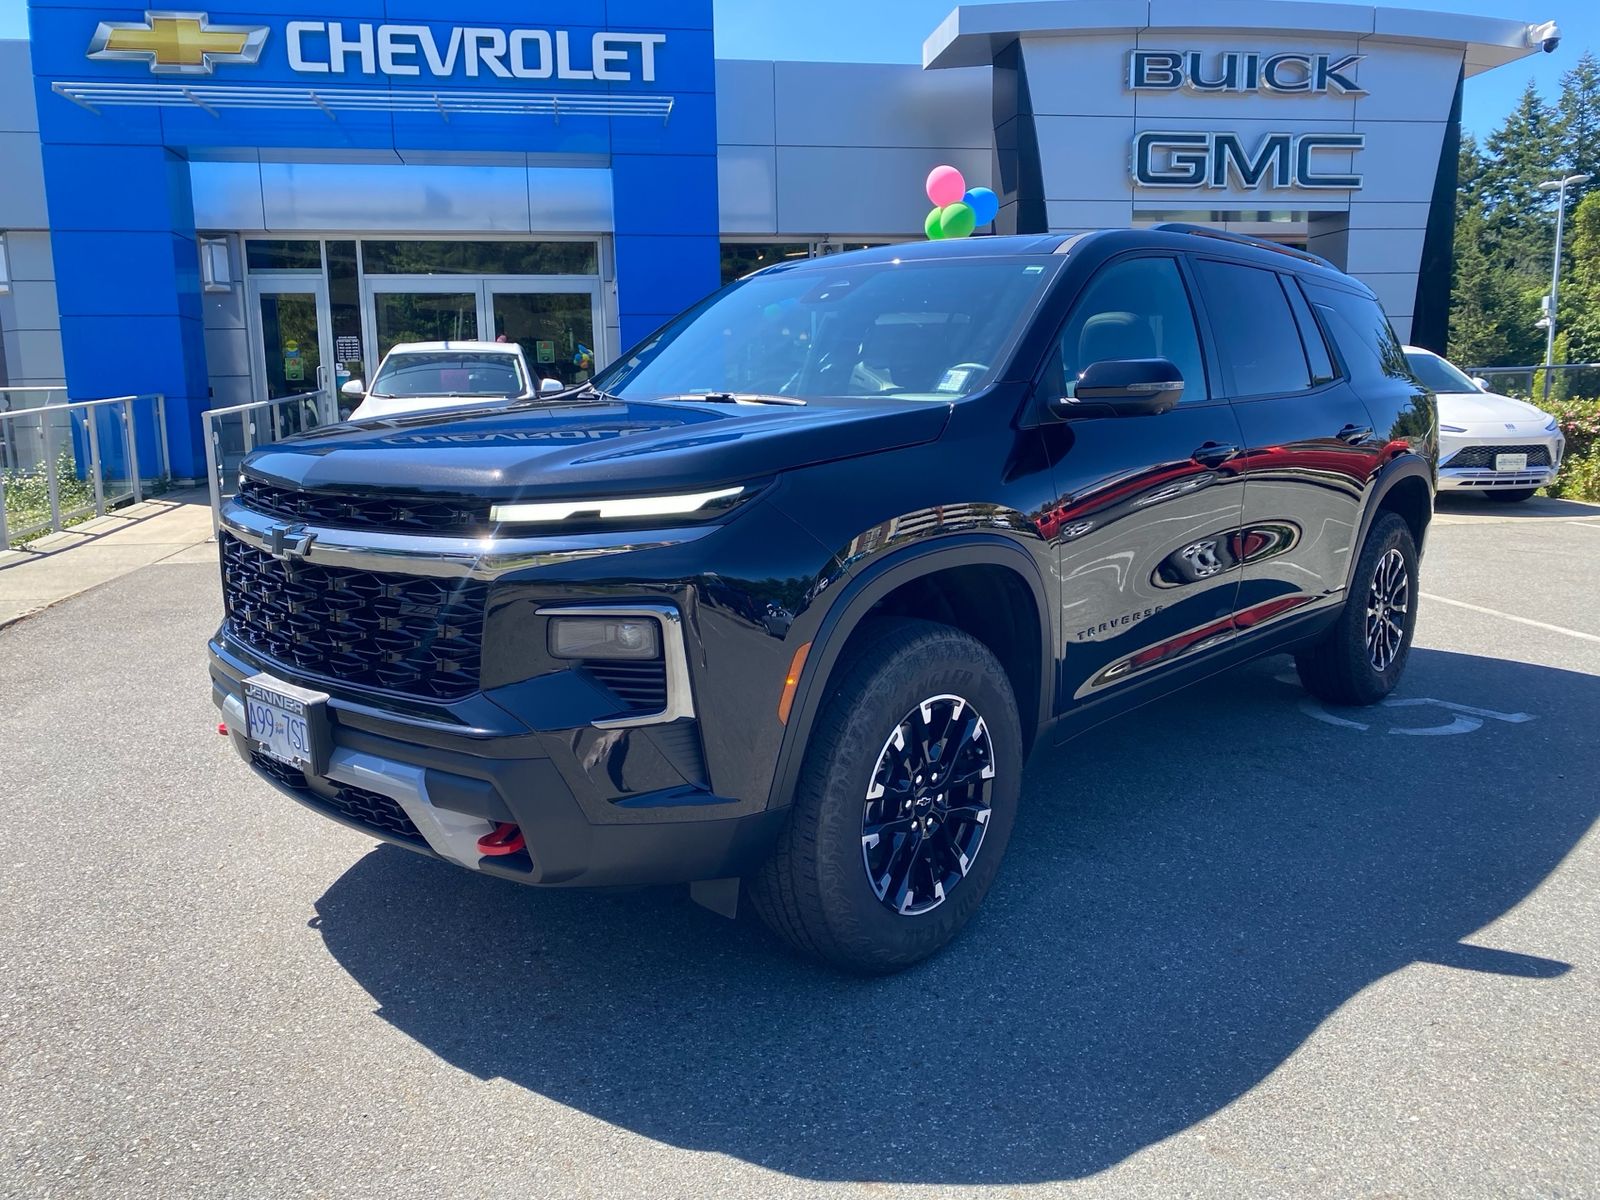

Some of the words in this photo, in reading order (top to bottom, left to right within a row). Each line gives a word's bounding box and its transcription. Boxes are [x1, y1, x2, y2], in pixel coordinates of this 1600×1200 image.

[286, 21, 667, 82] CHEVROLET
[1128, 49, 1370, 96] BUICK
[1130, 131, 1366, 190] GMC
[1076, 605, 1164, 641] TRAVERSE
[244, 684, 304, 715] JENNER
